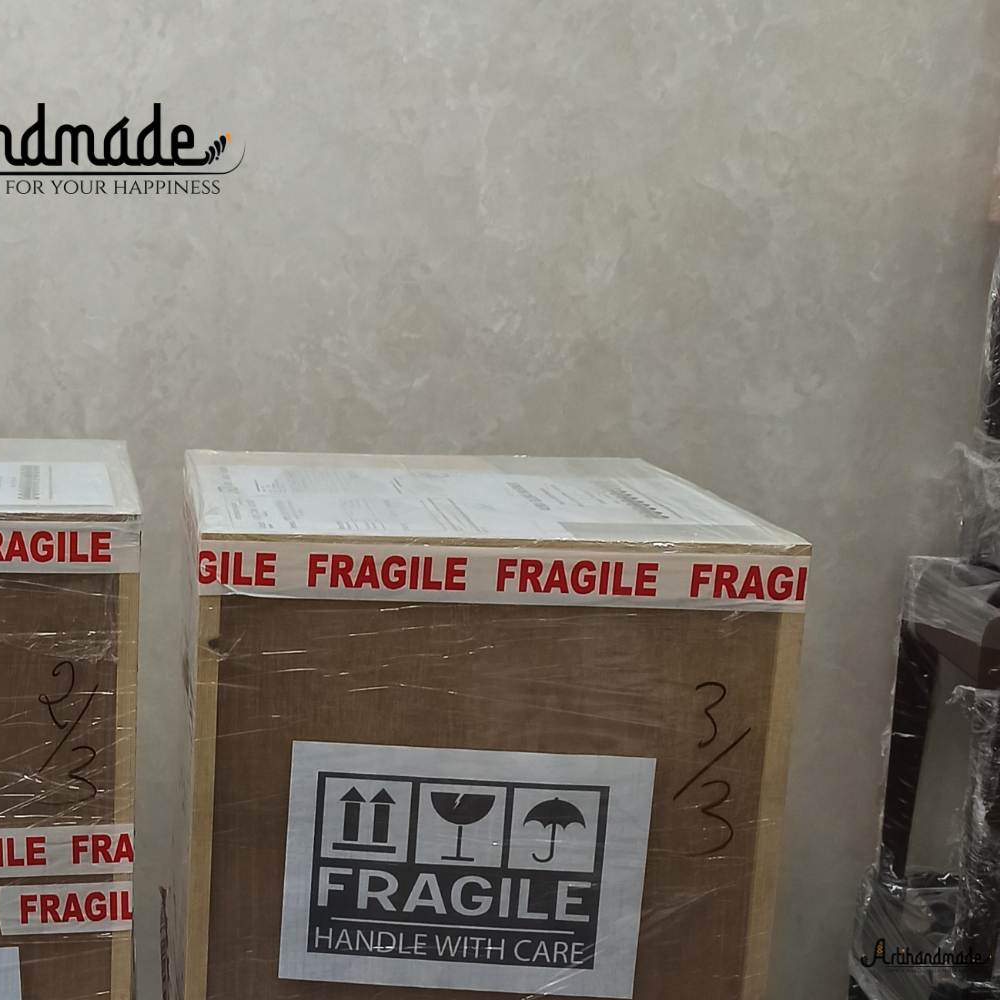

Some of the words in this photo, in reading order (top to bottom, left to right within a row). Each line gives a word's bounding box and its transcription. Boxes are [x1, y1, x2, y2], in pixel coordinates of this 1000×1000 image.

[198, 550, 277, 588] GILE
[308, 554, 469, 593] FRAGILE
[496, 558, 660, 598] FRAGILE
[690, 564, 808, 602] FRAGI
[71, 833, 135, 865] FRA
[20, 891, 134, 925] FRAGIL
[316, 866, 592, 923] FRAGILE
[314, 926, 428, 955] HANDLE
[435, 934, 505, 961] WITH
[513, 939, 585, 965] CARE
